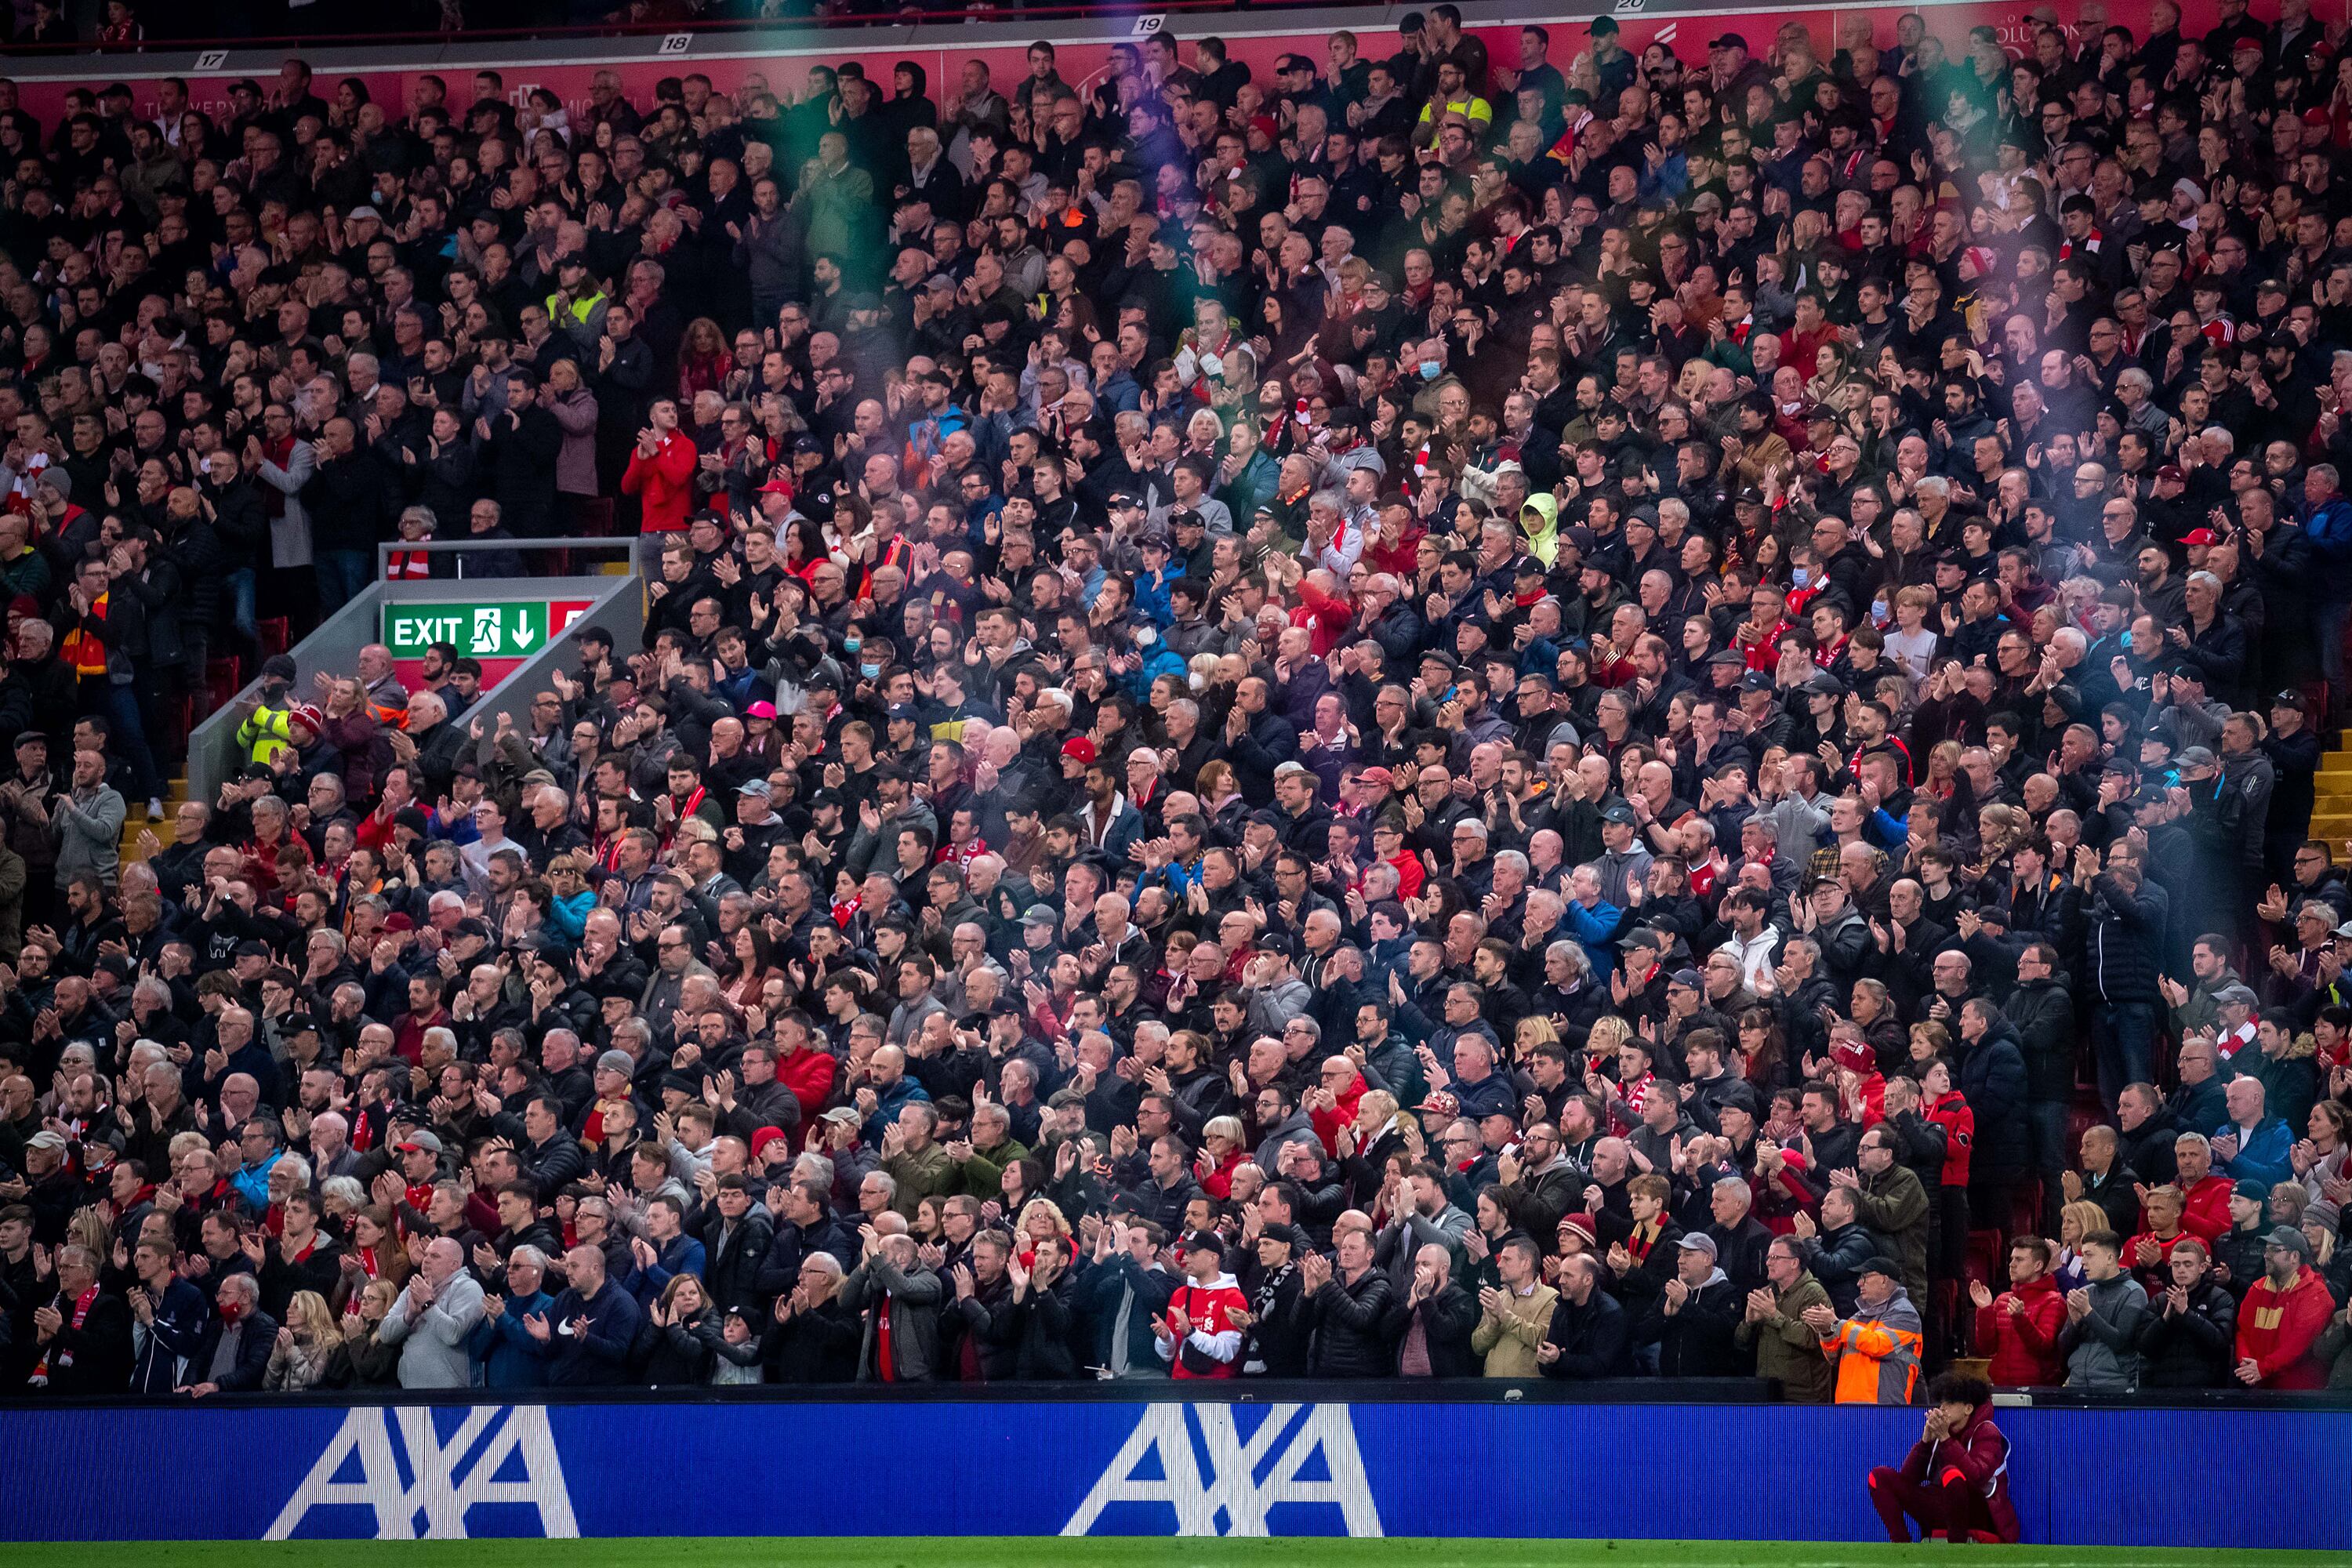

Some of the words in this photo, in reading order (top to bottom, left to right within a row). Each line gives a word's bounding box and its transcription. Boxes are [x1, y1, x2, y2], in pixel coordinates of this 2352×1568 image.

[1139, 18, 1160, 31] 19
[666, 37, 688, 50] 18
[202, 54, 223, 67] 17
[394, 617, 463, 646] EXIT
[262, 1404, 580, 1541] AXA
[1058, 1402, 1385, 1538] AXA
